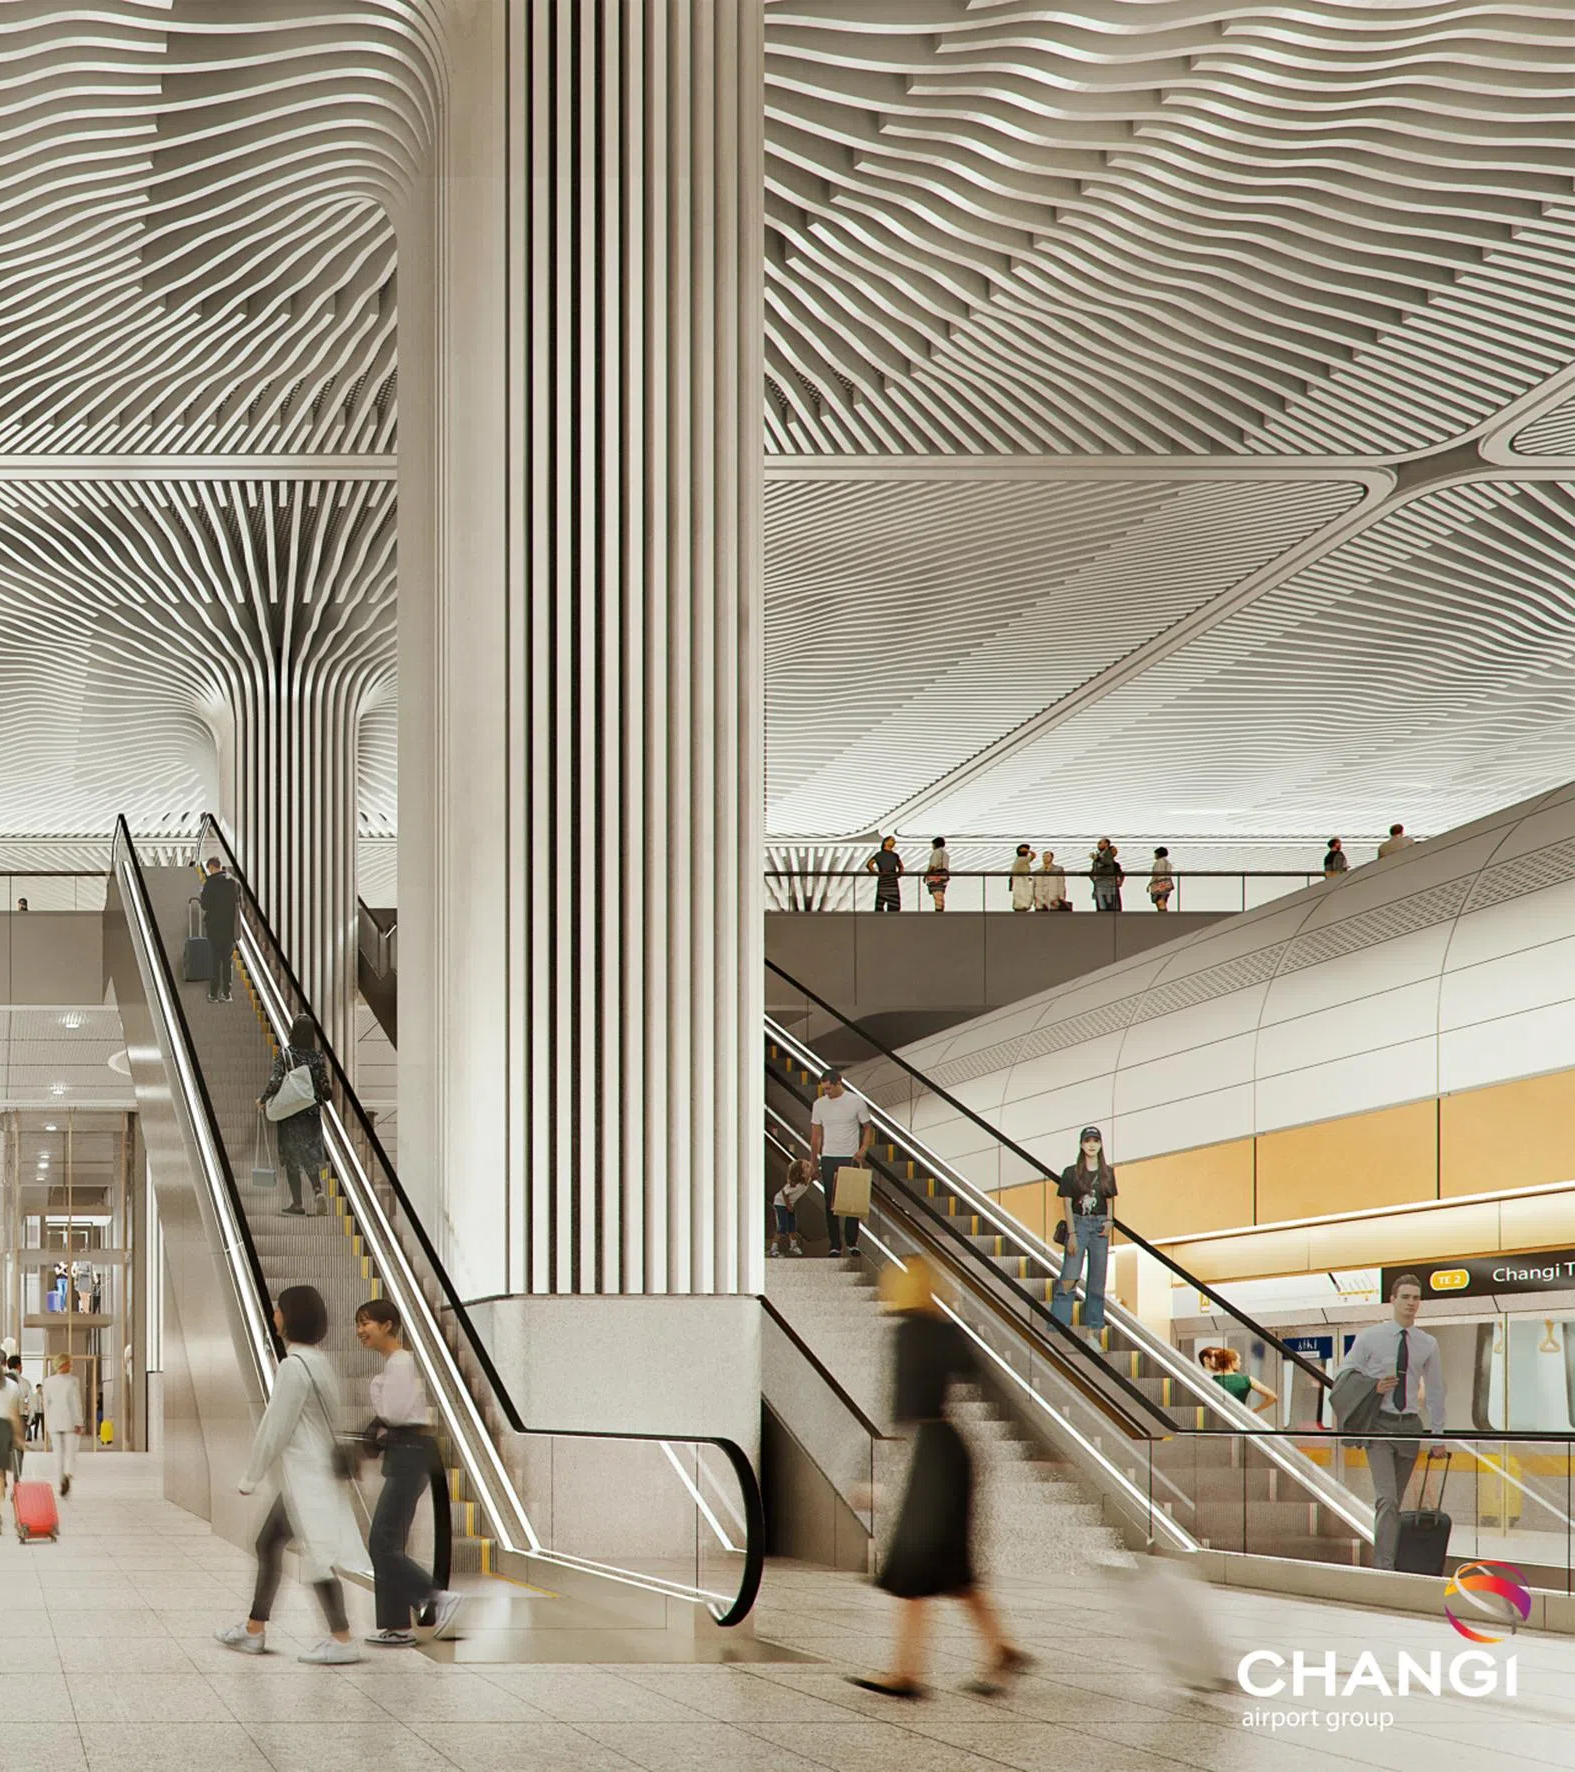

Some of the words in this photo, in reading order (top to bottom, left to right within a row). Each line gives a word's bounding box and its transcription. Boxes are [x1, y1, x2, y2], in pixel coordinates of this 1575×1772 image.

[1492, 1263, 1560, 1282] Changi
[1439, 1276, 1451, 1285] TE
[1454, 1275, 1461, 1284] 2
